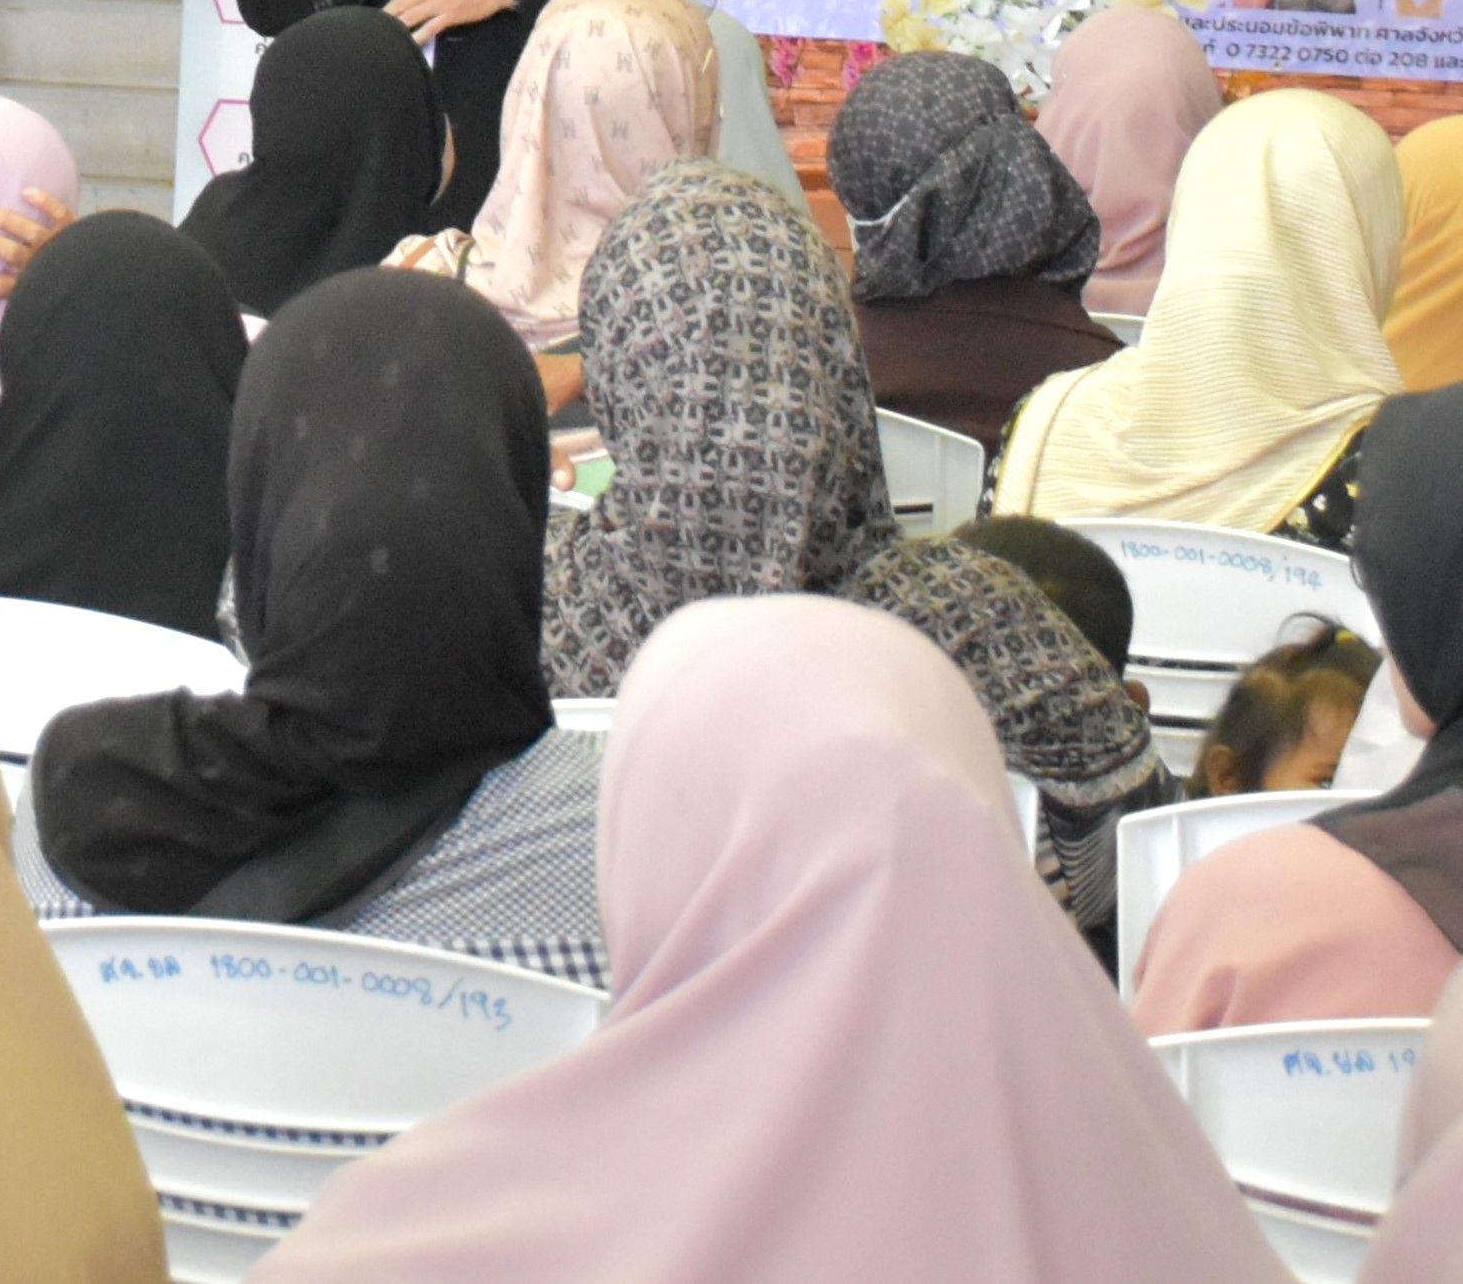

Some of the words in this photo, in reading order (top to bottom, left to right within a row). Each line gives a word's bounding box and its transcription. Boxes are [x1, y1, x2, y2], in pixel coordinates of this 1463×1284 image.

[1226, 43, 1240, 57] 0
[1245, 43, 1291, 61] 7322
[1298, 47, 1349, 64] 0750
[1354, 47, 1382, 65] ต่อ
[1389, 51, 1428, 69] 208
[210, 953, 515, 1032] 1800-001-0008/193
